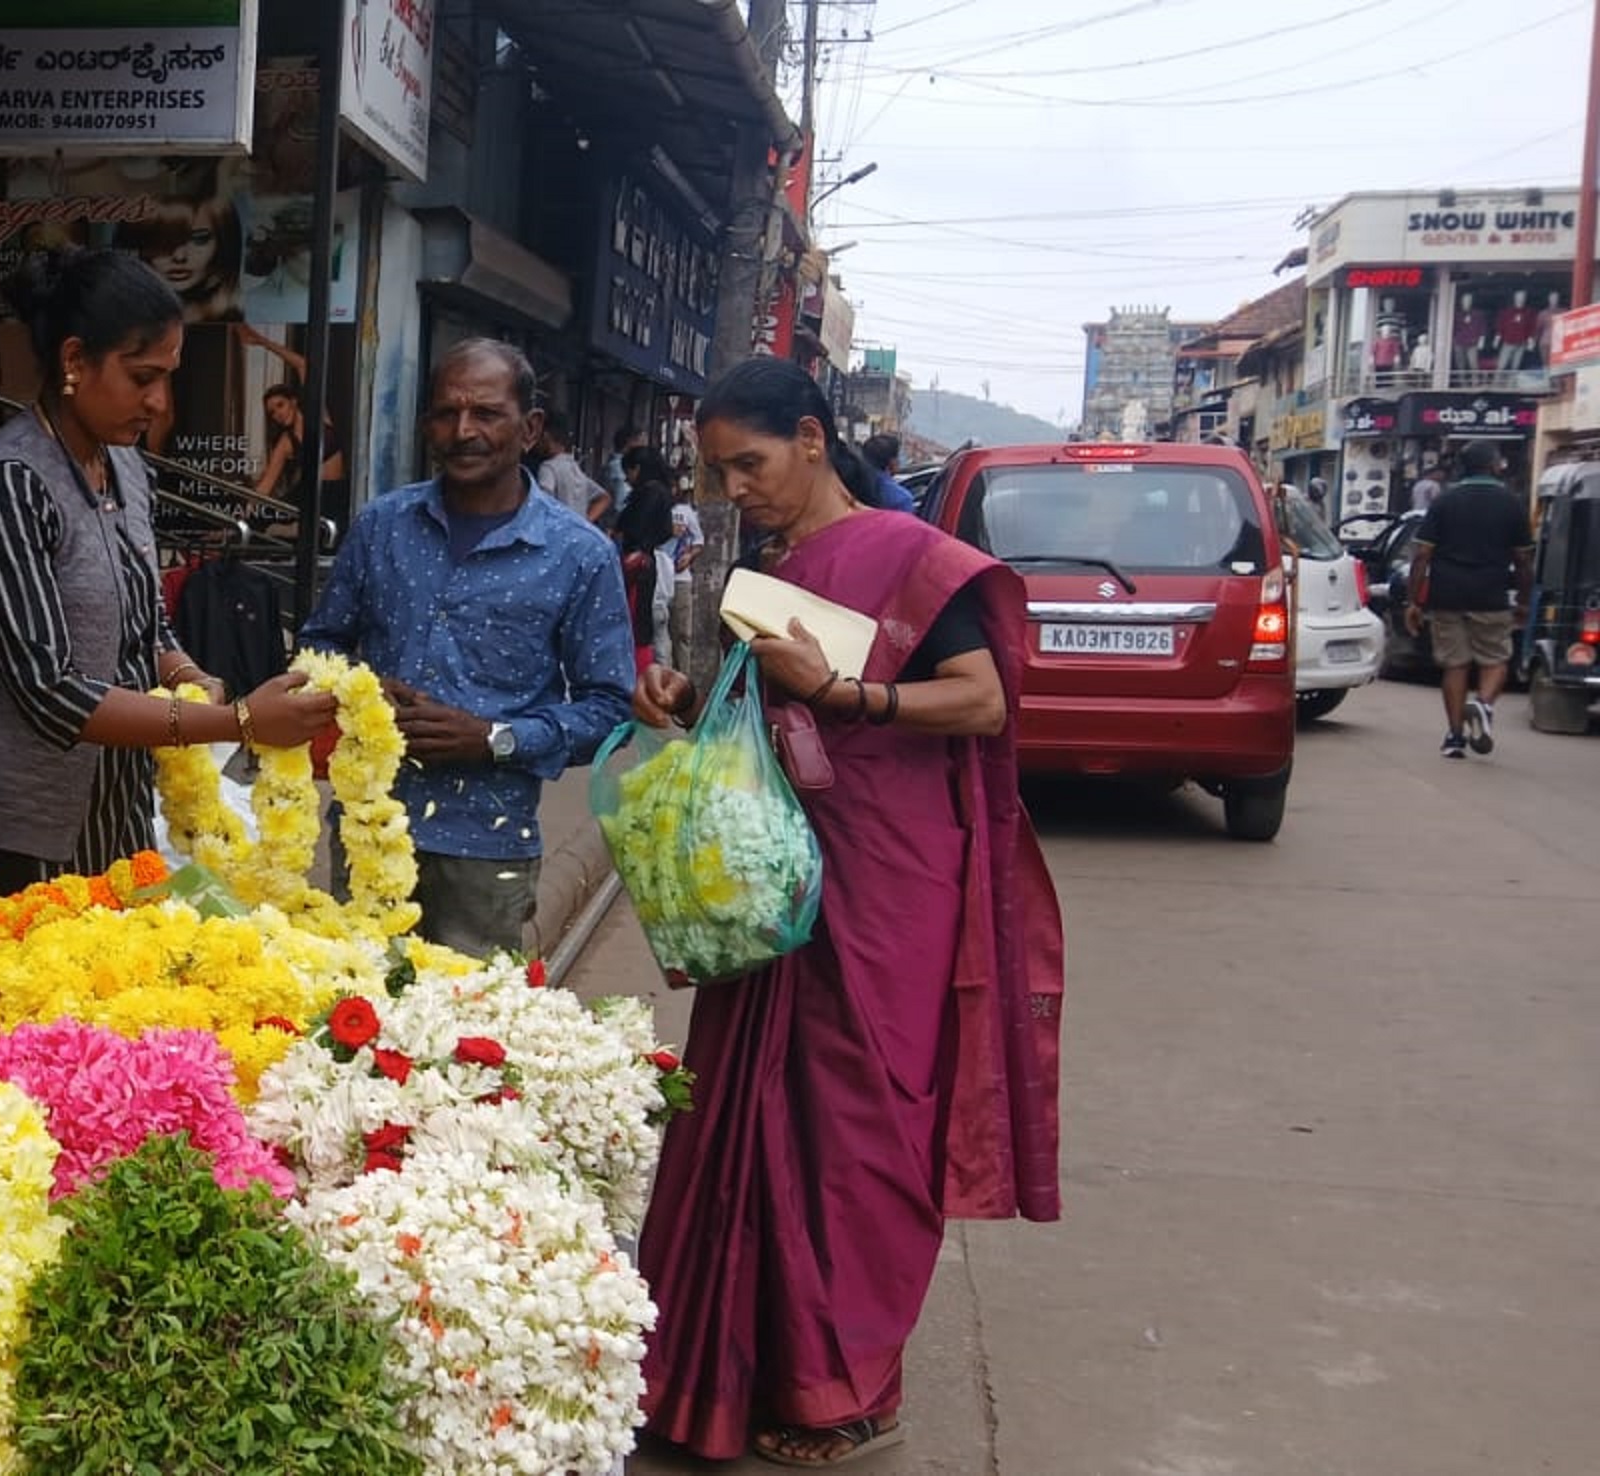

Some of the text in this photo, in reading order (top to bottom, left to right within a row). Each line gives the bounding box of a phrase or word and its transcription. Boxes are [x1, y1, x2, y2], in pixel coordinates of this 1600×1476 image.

[61, 89, 206, 110] ENTERPRISES
[0, 114, 157, 129] MOB: 9448070951
[1407, 209, 1576, 232] SNOW WHITE
[1421, 230, 1558, 247] GENTS & BOYS
[1346, 266, 1424, 289] SHIRTS
[175, 434, 250, 451] WHERE
[171, 458, 260, 474] OMFORT
[1052, 628, 1171, 651] KA03MT9826
